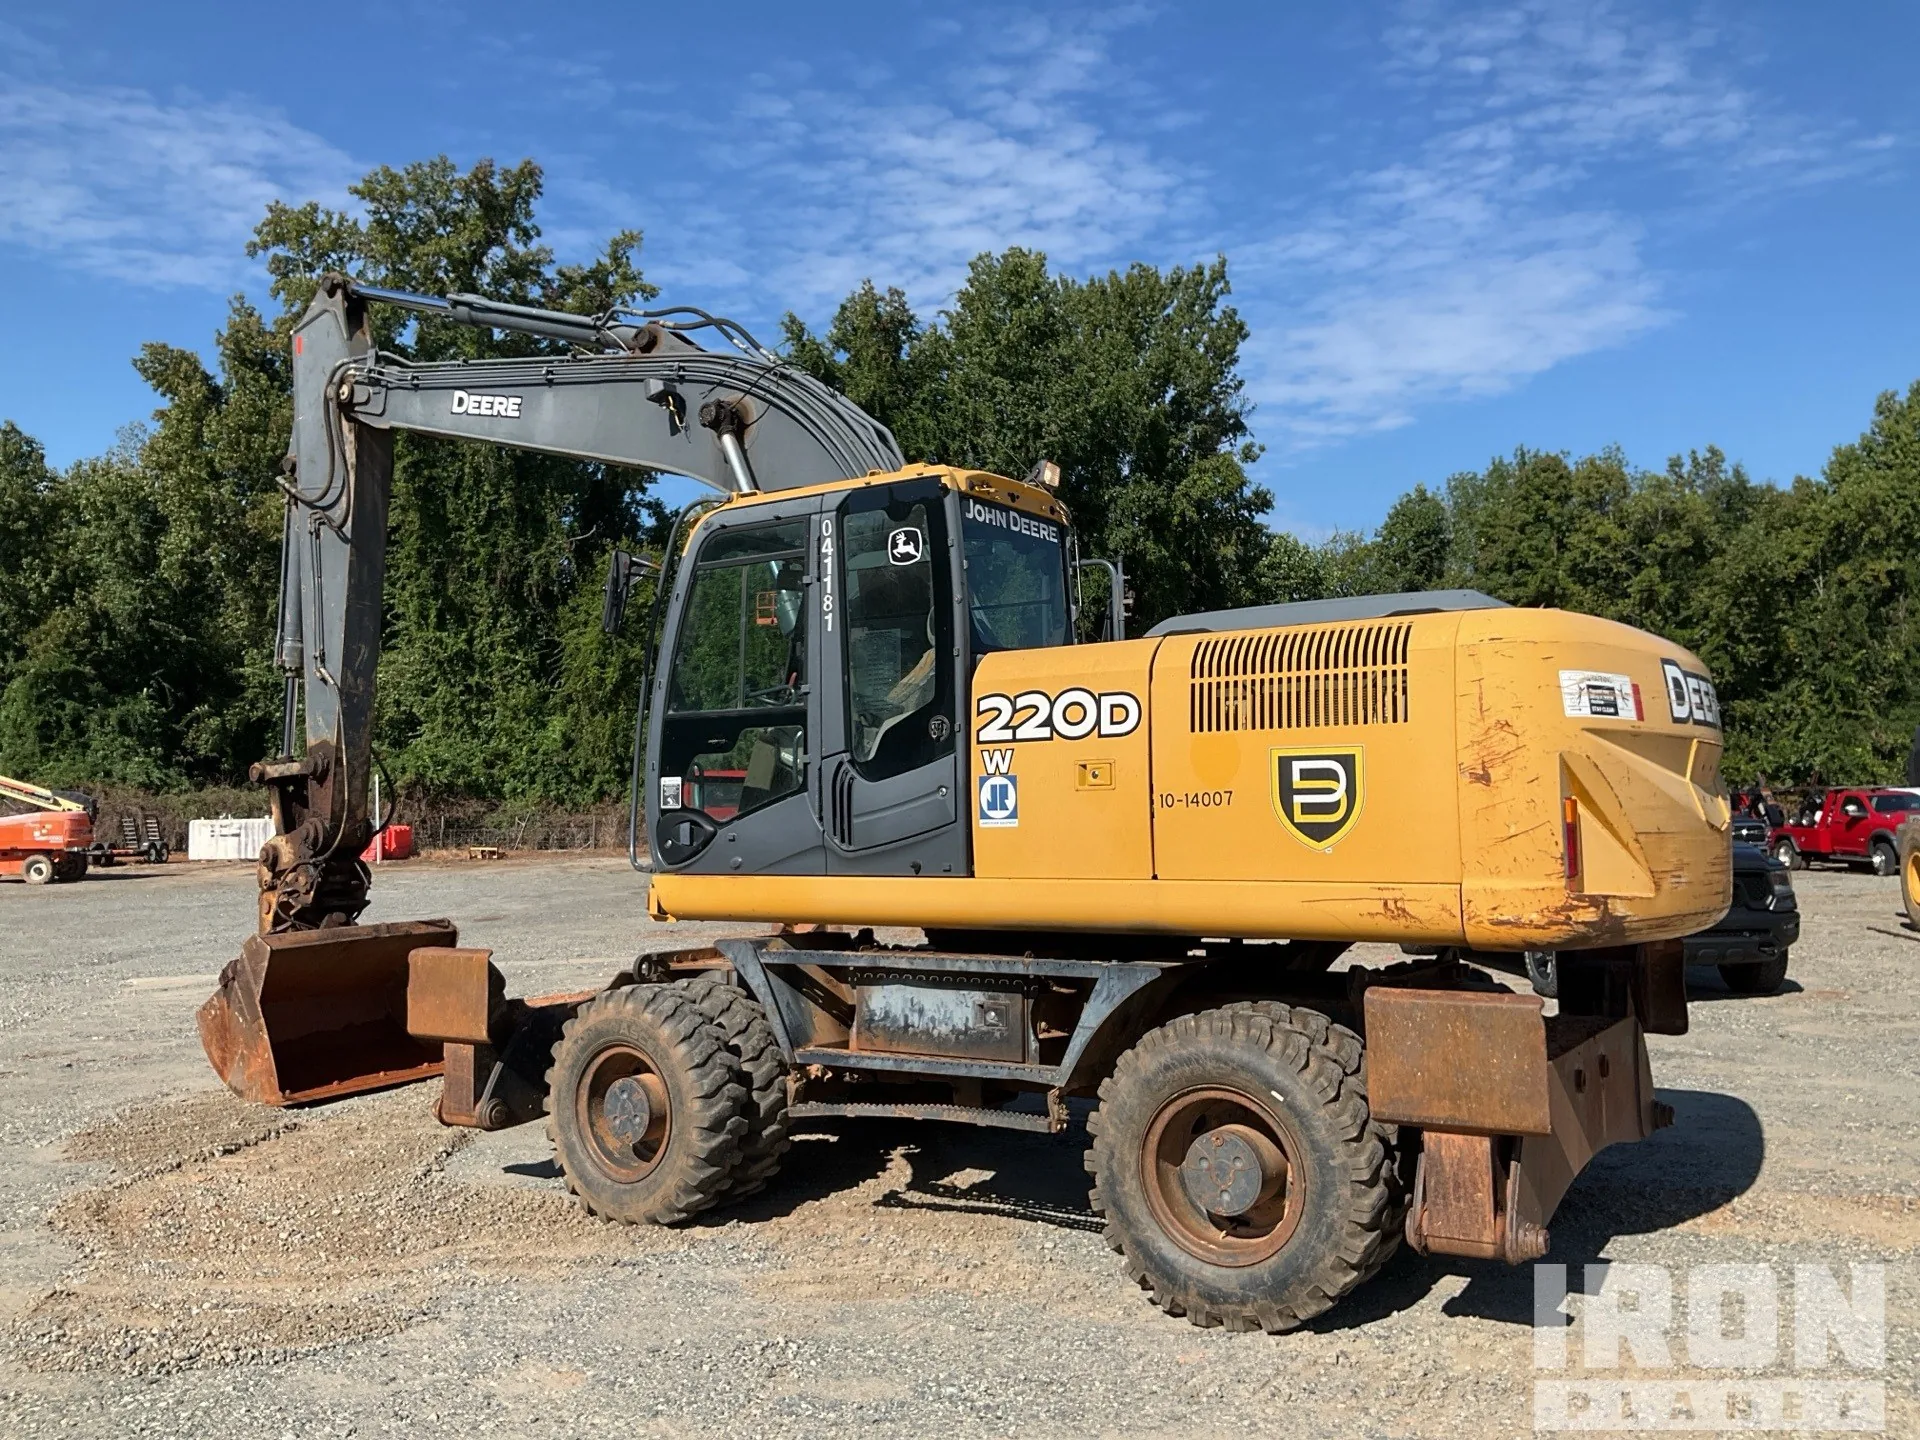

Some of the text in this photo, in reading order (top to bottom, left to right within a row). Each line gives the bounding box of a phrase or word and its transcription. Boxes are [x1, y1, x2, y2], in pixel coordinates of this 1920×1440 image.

[451, 389, 523, 419] DEERE
[965, 498, 1058, 543] JOHN DEERE
[821, 519, 834, 632] 041181
[977, 687, 1142, 745] 220D
[981, 749, 1015, 775] W
[1159, 790, 1233, 809] 10-14007
